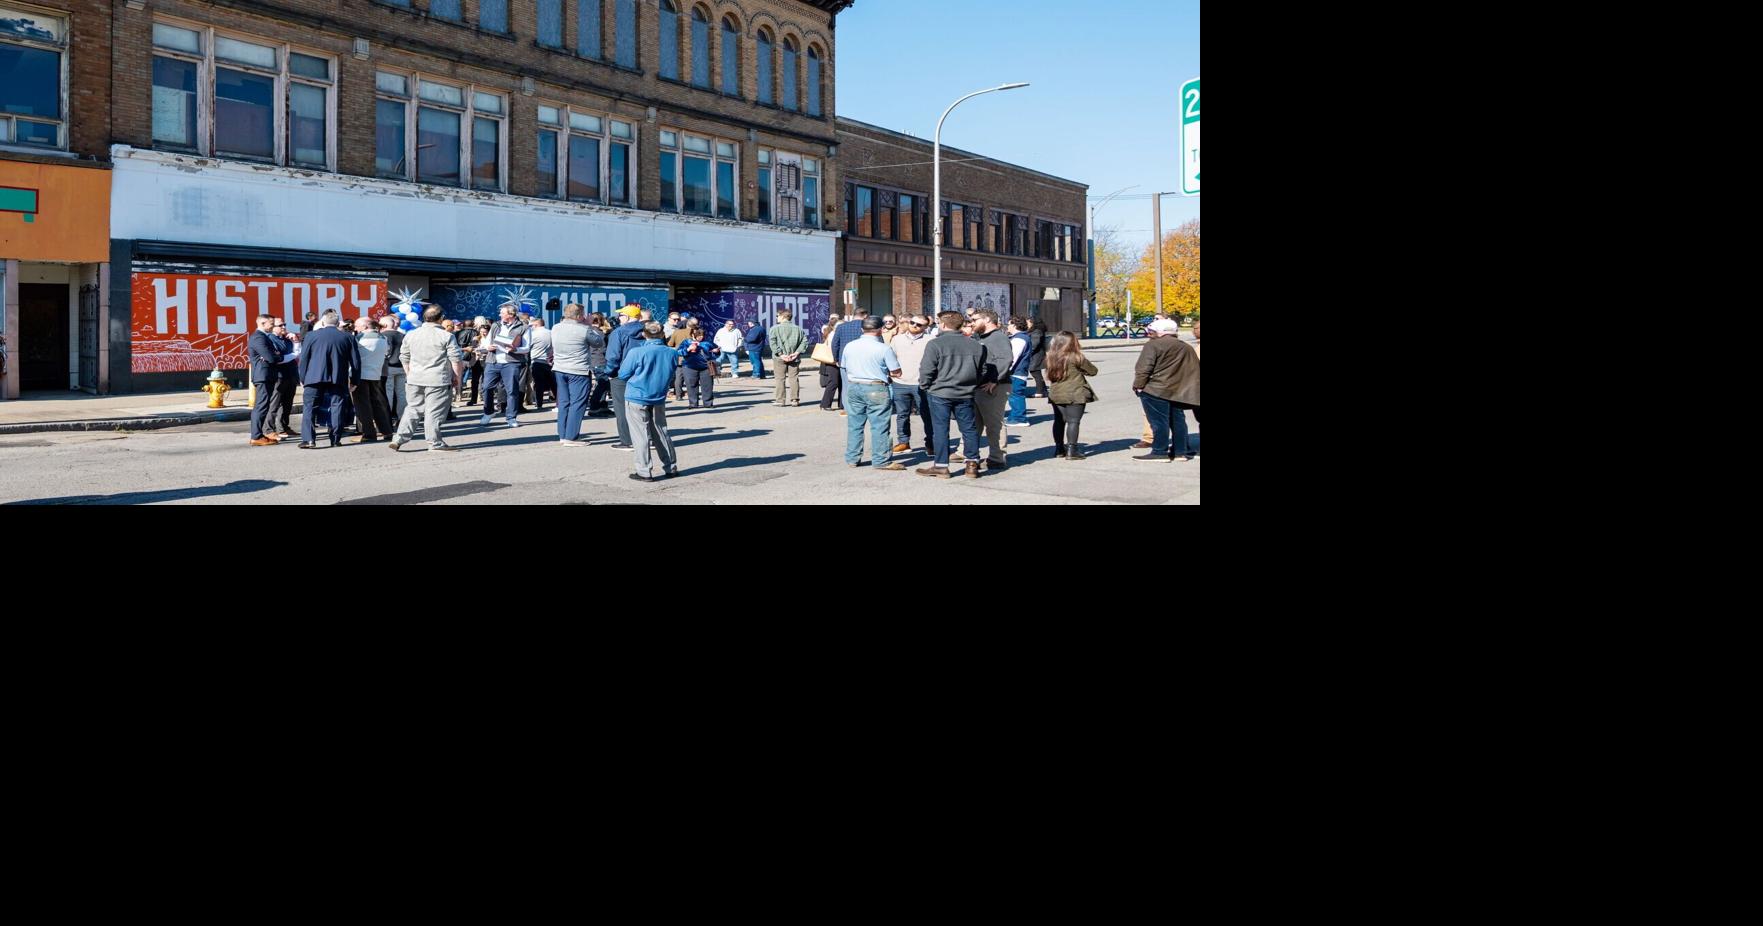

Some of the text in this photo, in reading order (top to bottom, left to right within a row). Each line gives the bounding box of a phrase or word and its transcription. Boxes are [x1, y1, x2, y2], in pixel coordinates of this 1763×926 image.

[1191, 148, 1200, 162] T
[152, 278, 377, 334] HISTORY
[757, 295, 809, 335] HERE
